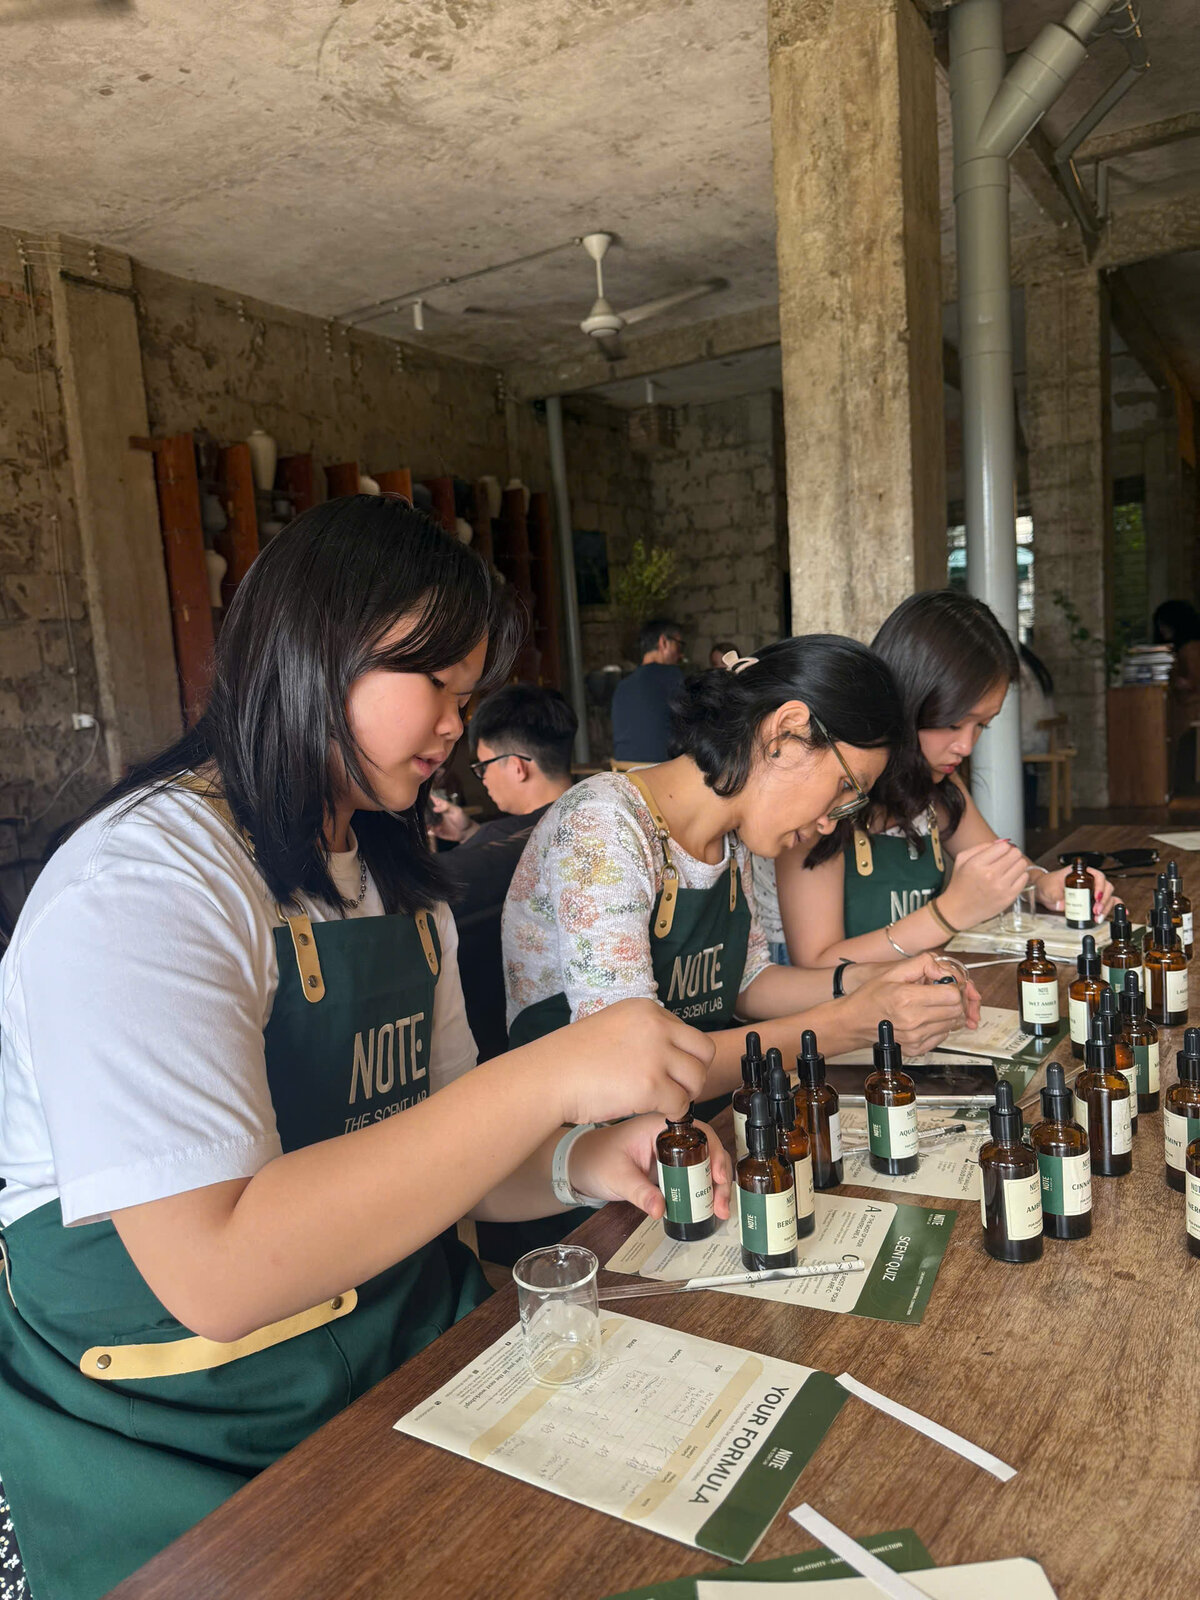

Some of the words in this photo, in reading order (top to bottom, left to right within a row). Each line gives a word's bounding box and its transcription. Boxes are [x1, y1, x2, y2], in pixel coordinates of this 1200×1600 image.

[666, 943, 724, 1001] NOTE
[682, 1001, 708, 1019] SCENT
[709, 996, 723, 1013] LAB
[348, 1011, 427, 1105] NOTE
[1042, 1176, 1050, 1191] NOTE
[671, 1187, 679, 1202] NOTE
[865, 1205, 882, 1213] A
[747, 1213, 755, 1230] NOTE
[891, 1235, 911, 1261] SCENT
[882, 1261, 901, 1282] QUIZ
[626, 1338, 637, 1349] BASE
[668, 1349, 682, 1364] MIDDLE
[714, 1364, 723, 1373] TOP
[749, 1386, 790, 1426] YOUR
[688, 1427, 759, 1503] FORMULA
[768, 1448, 793, 1470] NOTE
[793, 1560, 826, 1574] CREATIVITY
